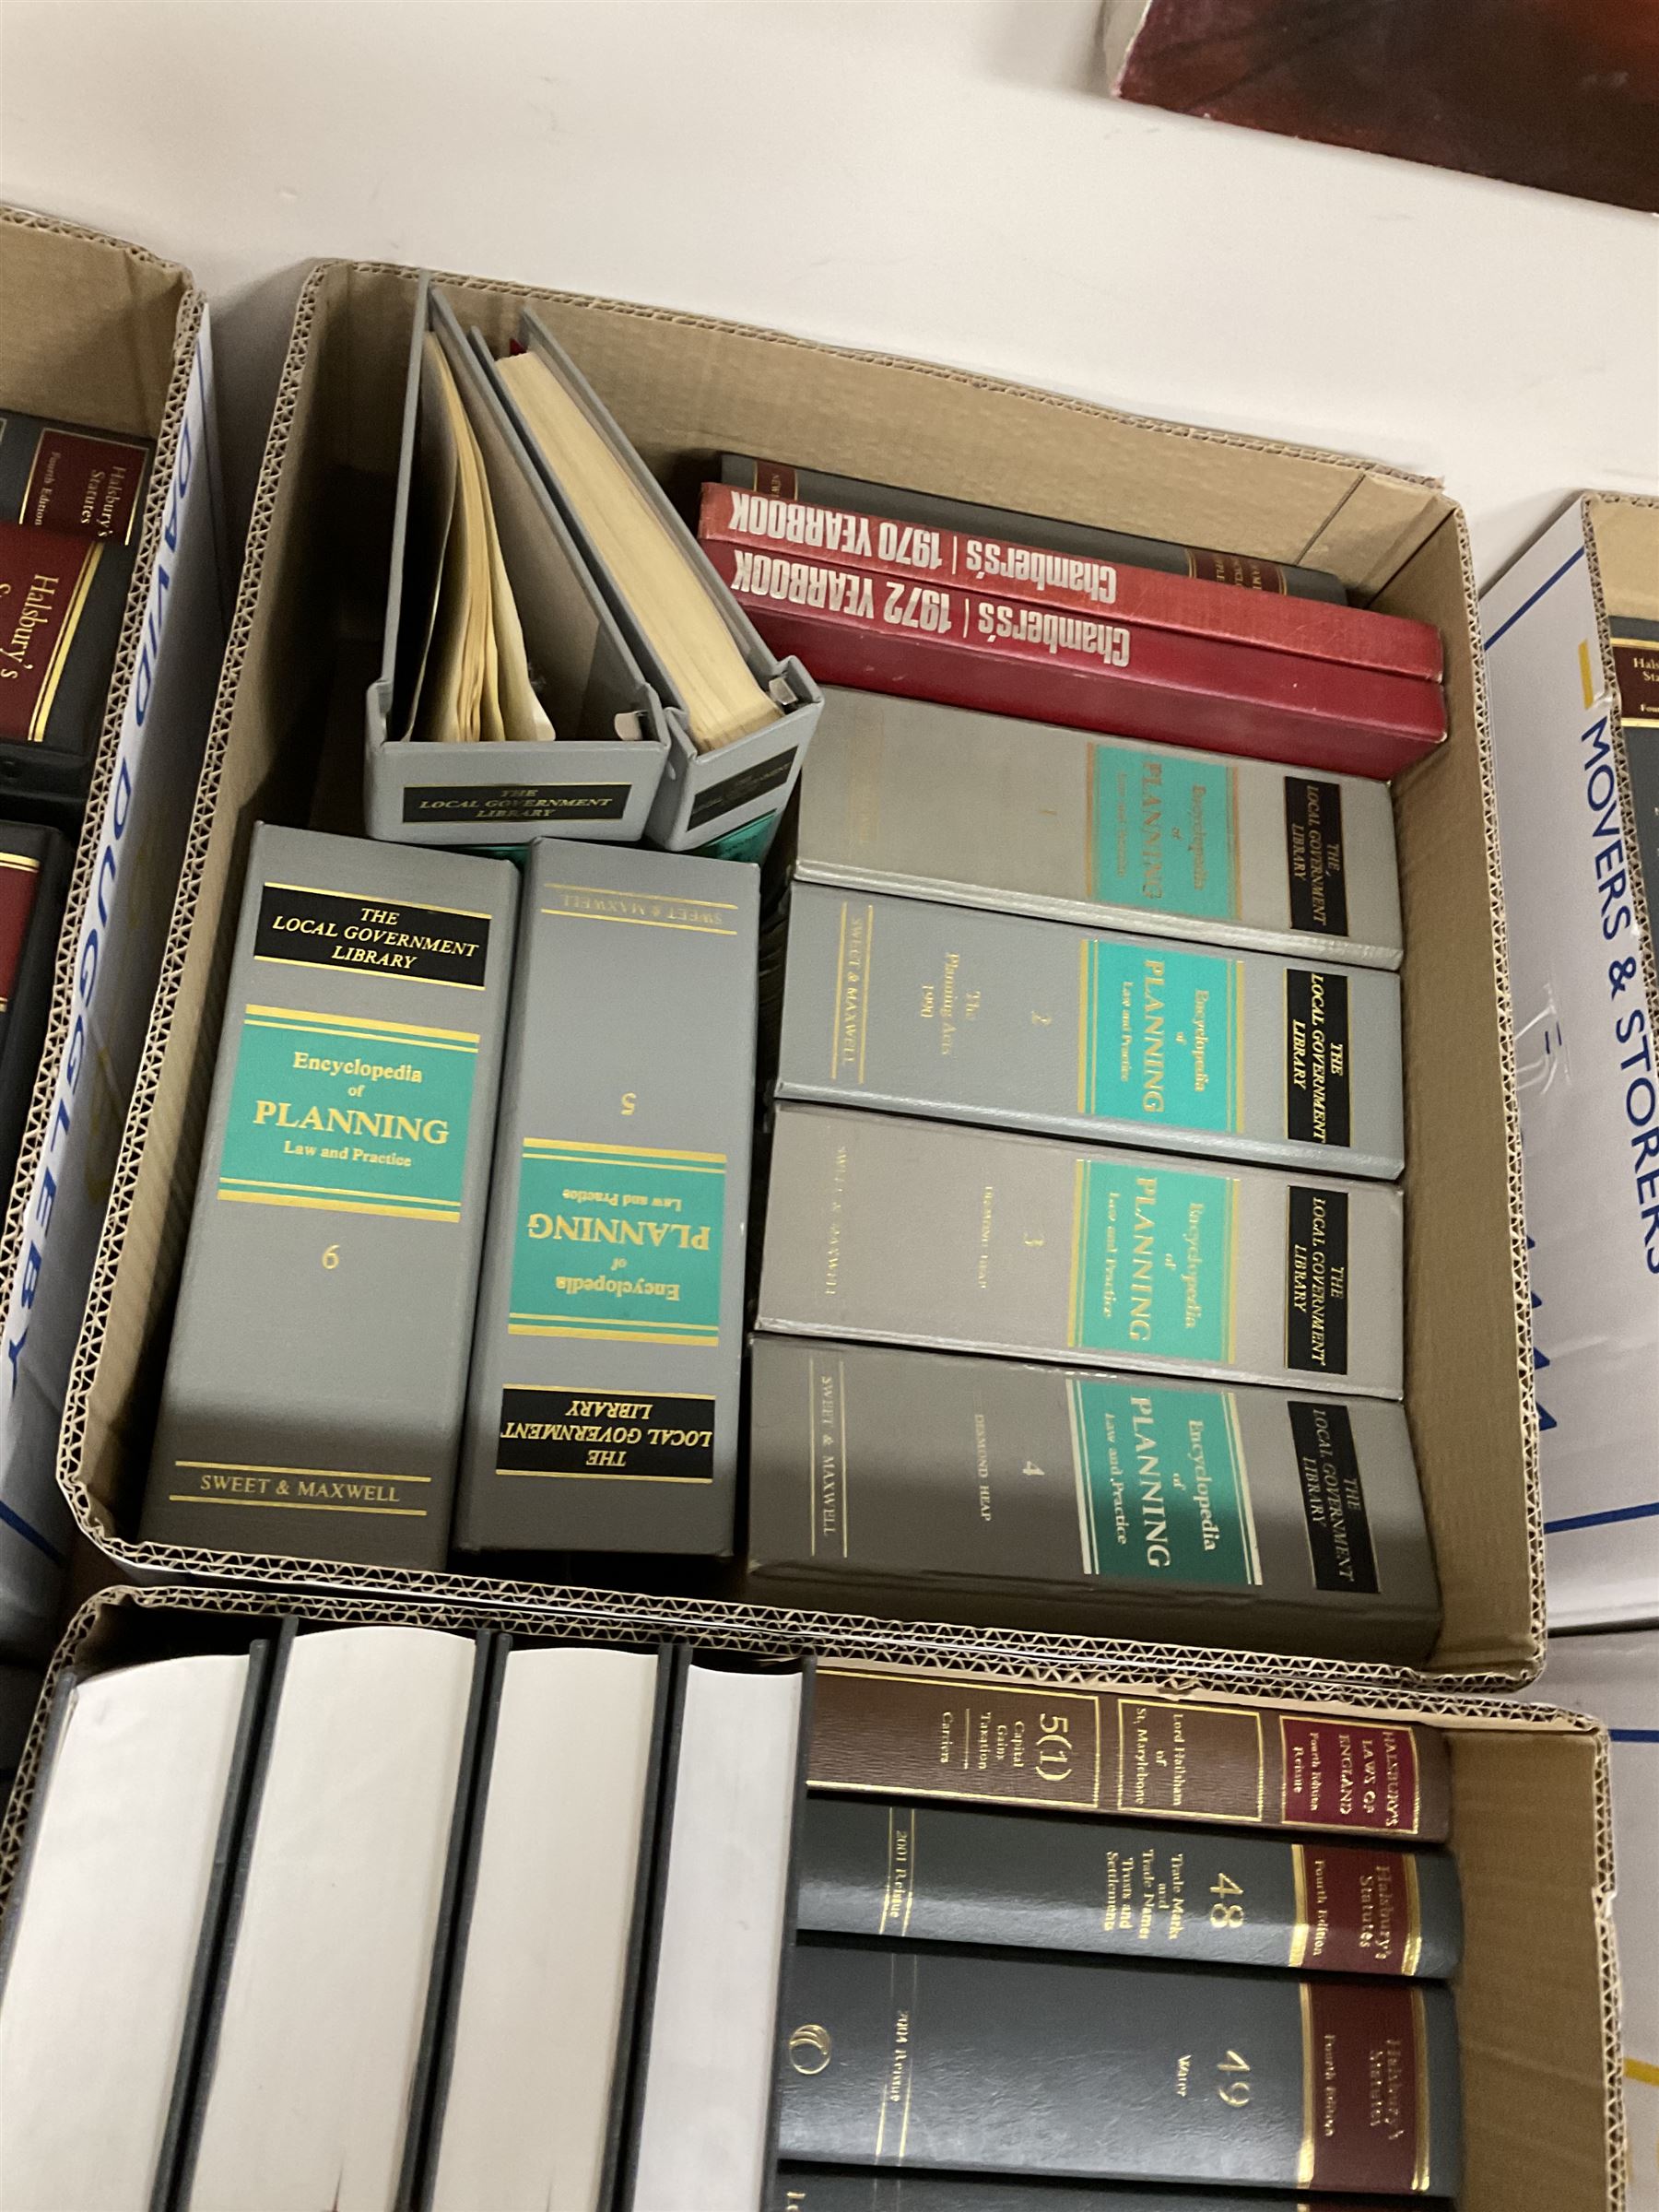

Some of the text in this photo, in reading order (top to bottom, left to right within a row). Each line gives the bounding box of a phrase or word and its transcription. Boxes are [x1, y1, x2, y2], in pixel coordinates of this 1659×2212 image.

[34, 451, 61, 526] Fourth Edition
[80, 470, 105, 524] Statutes
[98, 465, 126, 537] Halsbury's
[728, 491, 871, 555] YEARBOOK
[877, 522, 942, 571] 1970
[136, 418, 193, 727] DAVID
[731, 549, 874, 618] YEARBOOK
[0, 573, 59, 680] Halsbury's
[884, 582, 952, 634] 1972
[419, 797, 613, 809] LOCAL GOVERNMENT
[1141, 760, 1163, 900] PLANNING
[1291, 823, 1306, 881] LIBRARY
[1305, 784, 1327, 927] LOCAL GOVERNMENT
[1327, 842, 1340, 871] THE
[1581, 715, 1631, 941] MOVERS
[1608, 955, 1637, 1002] &
[272, 915, 480, 958] LOCAL GOVERNMENT
[359, 907, 400, 925] THE
[331, 945, 418, 970] LIBRARY
[940, 952, 960, 1018] Planning
[842, 916, 863, 1065] SWEET & MAXWELL
[1030, 1010, 1053, 1027] 2
[1120, 981, 1135, 1084] Law and Practice
[1141, 959, 1166, 1113] PLANNING
[1174, 1030, 1187, 1046] of
[1191, 989, 1210, 1092] Encyclopedia
[1292, 1018, 1308, 1091] LIBRARY
[1310, 972, 1327, 1145] LOCAL GOVERNMENT
[1330, 1041, 1345, 1077] THE
[292, 1051, 423, 1084] Encyclopedia
[347, 1084, 366, 1098] of
[252, 1099, 450, 1146] PLANNING
[620, 1092, 637, 1116] 5
[284, 1140, 413, 1168] Law and Practice
[526, 1212, 712, 1252] PLANNING
[561, 1188, 683, 1213] Law and Practice
[322, 1243, 341, 1270] 6
[610, 1257, 628, 1271] of
[1102, 1192, 1121, 1319] Law and Practice
[1127, 1177, 1159, 1342] PLANNING
[1164, 1253, 1177, 1272] of
[1181, 1202, 1206, 1330] Encyclopedia
[1293, 1243, 1308, 1313] LIBRARY
[1310, 1195, 1327, 1367] LOCAL GOVERNMENT
[1330, 1265, 1346, 1300] THE
[555, 1274, 681, 1302] Encyclopedia
[500, 1422, 714, 1448] LOCAL GOVERNMENT
[565, 1399, 653, 1420] LIBRARY
[585, 1449, 628, 1467] THE
[820, 1375, 837, 1536] SWEET & MAXWELL
[973, 1414, 992, 1522] DESMOND HEAP
[1021, 1460, 1045, 1477] 4
[1105, 1412, 1127, 1546] Law and Practice
[1129, 1394, 1172, 1569] PLANNING
[1171, 1472, 1186, 1490] of
[1187, 1418, 1221, 1552] Encyclopedia
[200, 1474, 401, 1503] SWEET & MAXWELL
[1301, 1455, 1327, 1528] LIBRARY
[1312, 1408, 1355, 1583] LOCAL GOVERNMENT
[1344, 1477, 1362, 1512] THE
[939, 1711, 954, 1765] Carriers
[977, 1712, 992, 1771] Taxation
[996, 1724, 1008, 1761] Gains
[1012, 1720, 1025, 1769] Capital
[1034, 1712, 1073, 1783] 5(1)
[1134, 1729, 1150, 1806] Marylebone
[1155, 1750, 1168, 1768] of
[1171, 1713, 1186, 1806] Lord Hailsham
[1308, 1731, 1320, 1771] Fourth
[1338, 1733, 1355, 1816] ENGLAND
[1360, 1739, 1376, 1815] LAWS OF
[1382, 1731, 1400, 1828] HALSBURY'S
[889, 1830, 909, 1919] 2001 Reissue
[1103, 1849, 1120, 1932] Settlements
[1118, 1856, 1135, 1930] Trusts and
[1138, 1848, 1156, 1940] Trade Names
[1157, 1882, 1171, 1911] and
[1169, 1853, 1186, 1941] Trade Marks
[1209, 1871, 1245, 1929] 48
[1312, 1859, 1329, 1958] Fourth Edition
[1359, 1874, 1373, 1948] Statutes
[1374, 1865, 1392, 1961] Halsbury's
[1217, 2049, 1251, 2108] 49
[1324, 2033, 1336, 2080] Fourth
